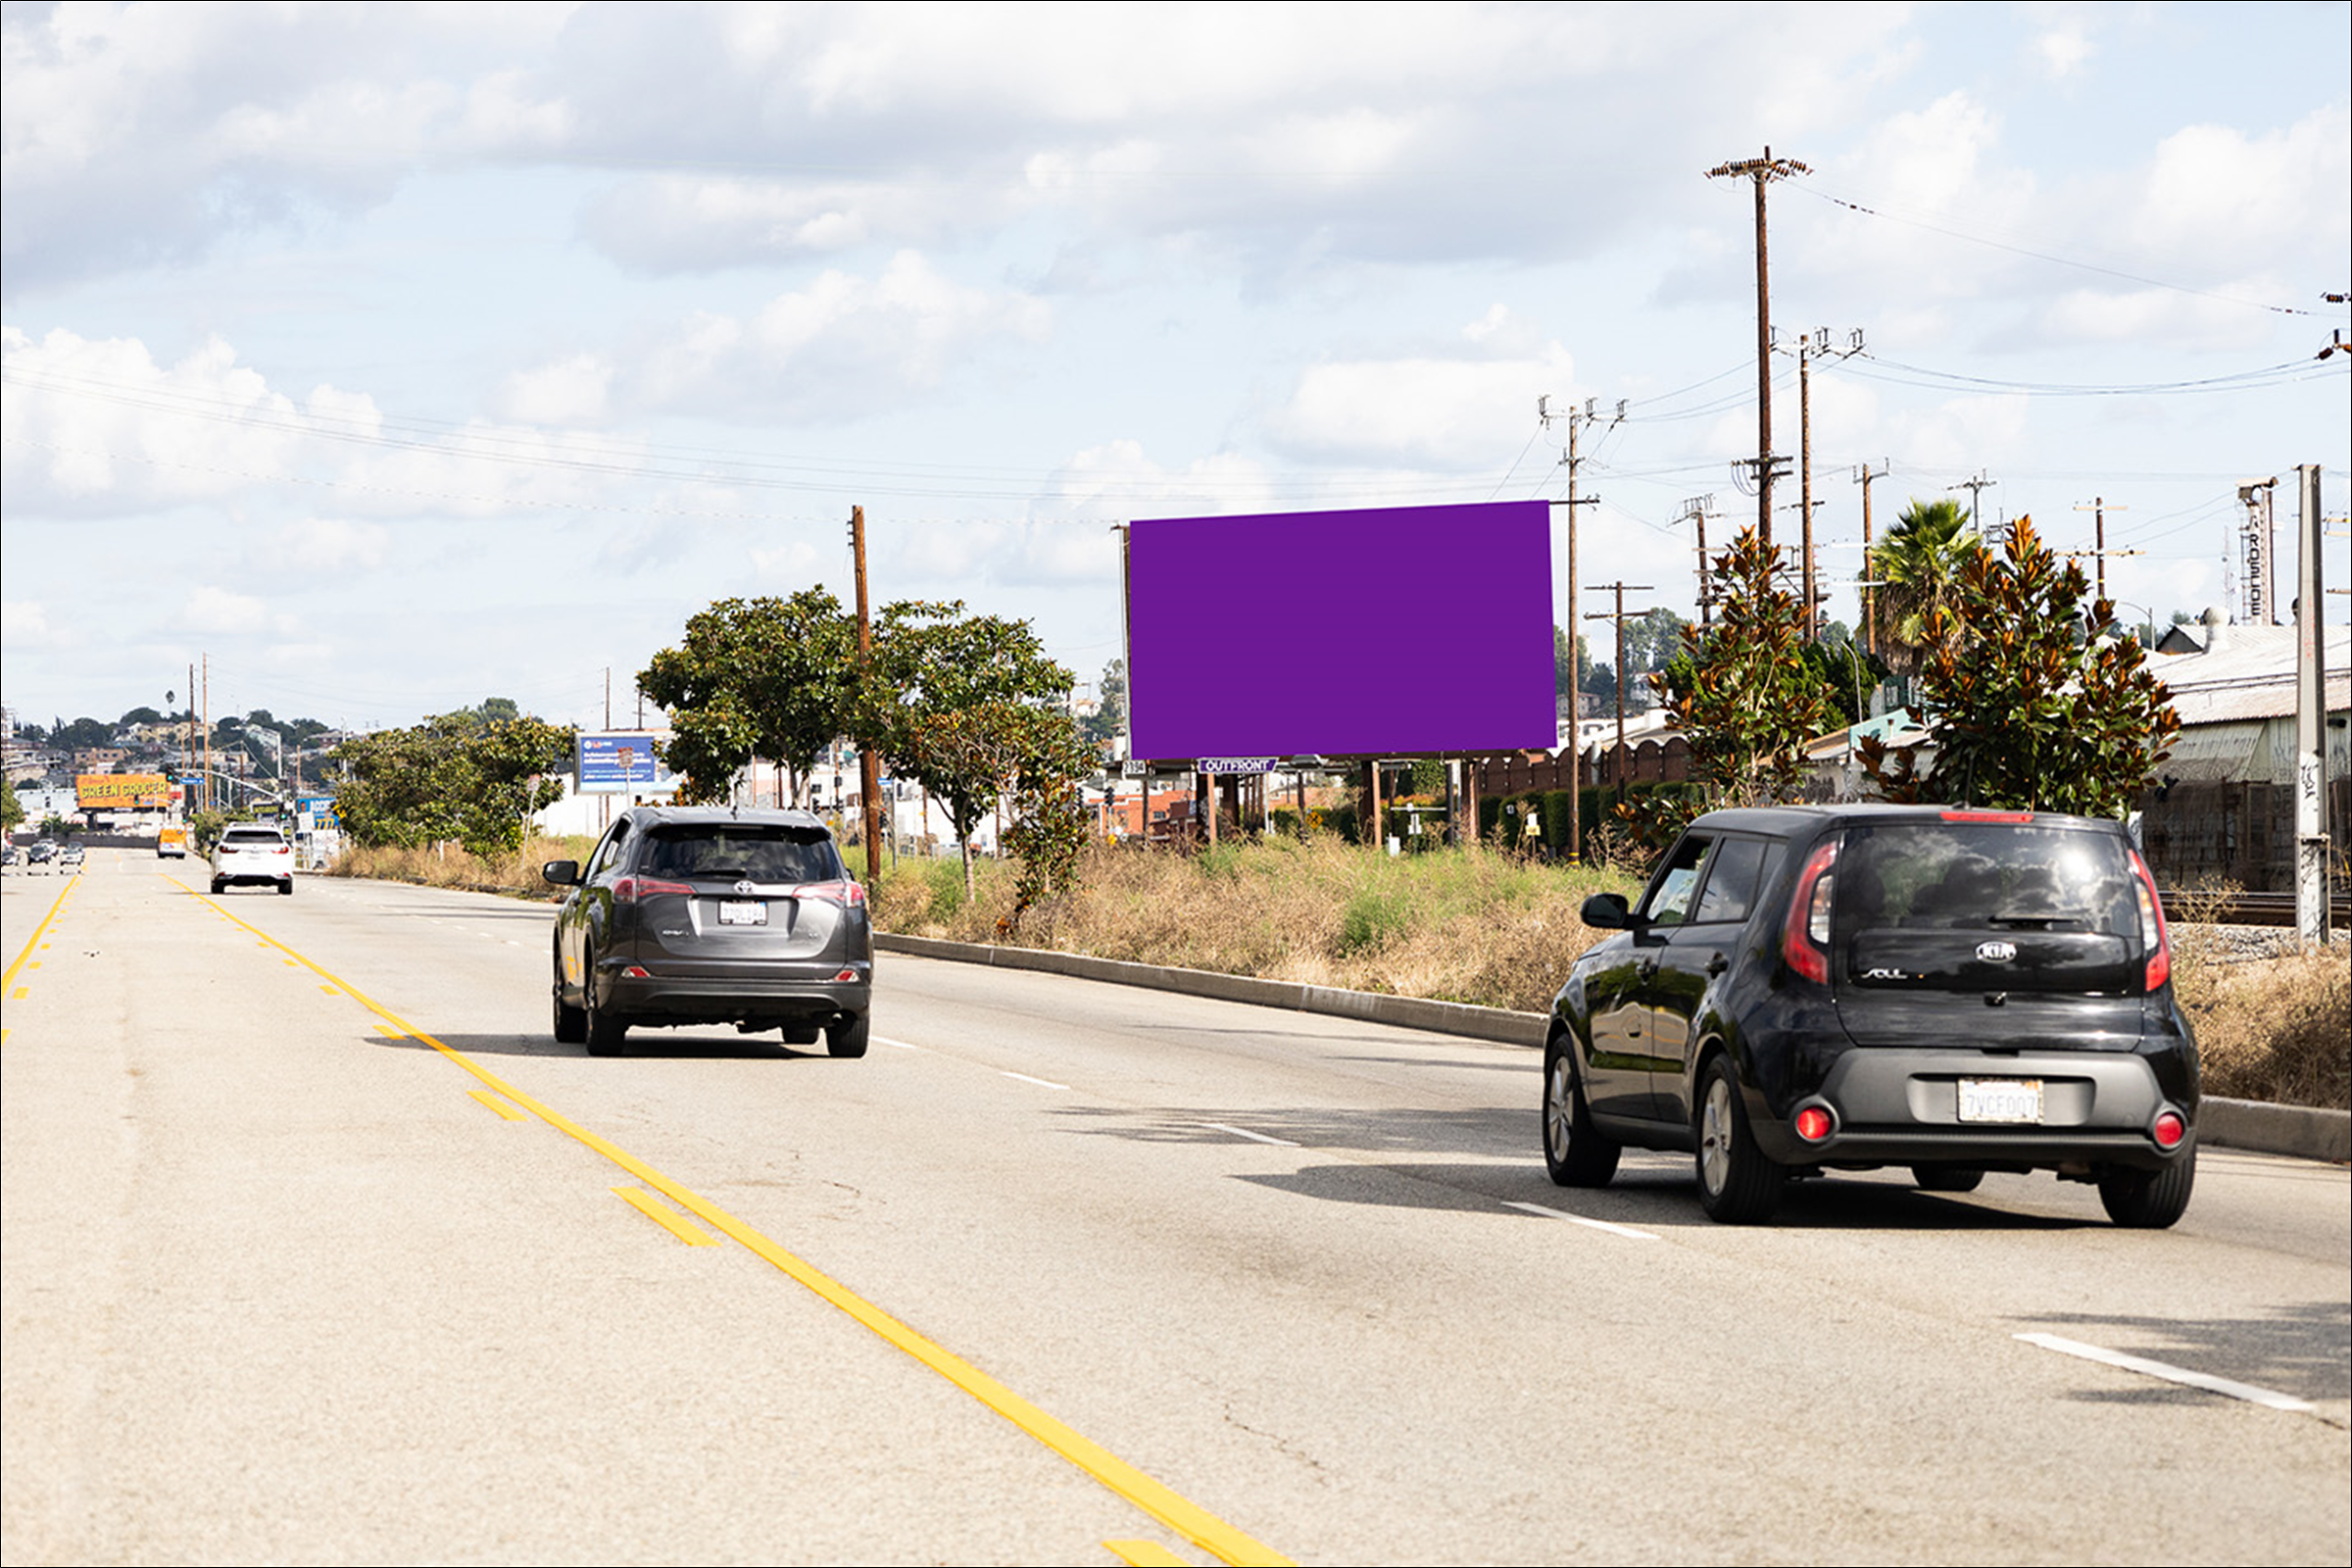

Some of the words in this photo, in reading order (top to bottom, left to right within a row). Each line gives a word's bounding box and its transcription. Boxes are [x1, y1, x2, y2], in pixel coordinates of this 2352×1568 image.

[2249, 533, 2261, 616] ROSCOE
[1204, 759, 1269, 771] OUTFRONT
[81, 785, 119, 799] GREEN
[122, 782, 167, 797] GROCER
[1980, 943, 2015, 959] KIA
[1966, 1094, 2036, 1115] 7VCF007
